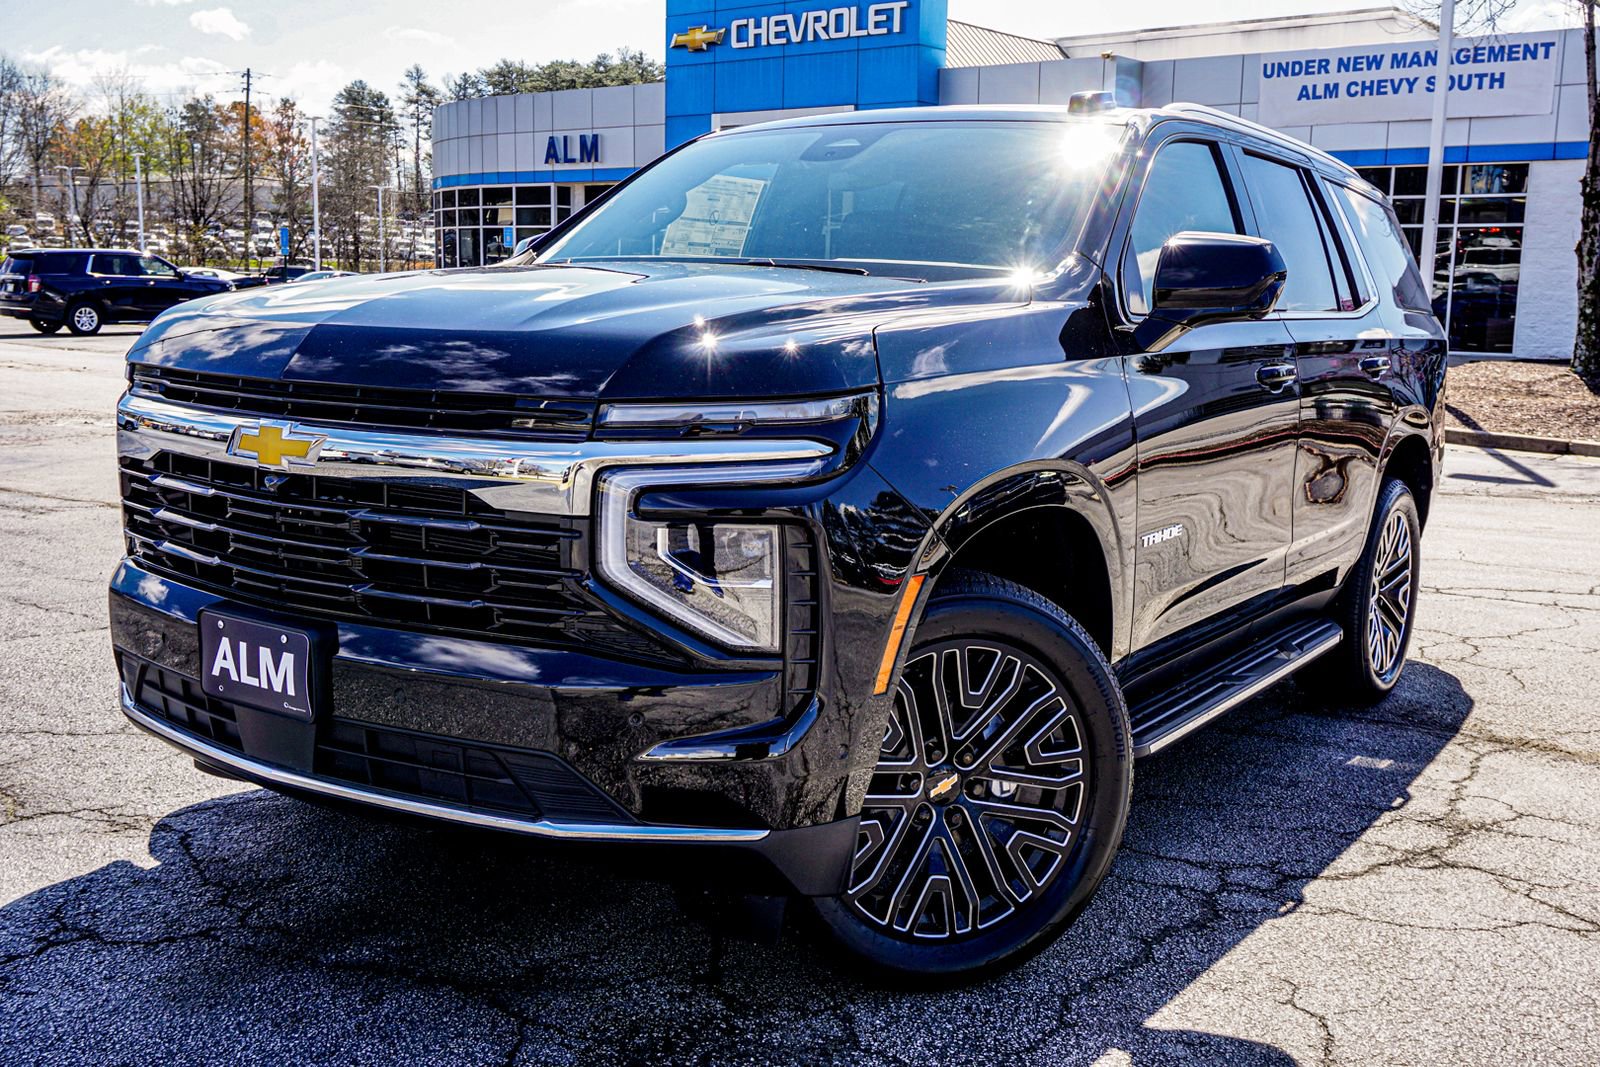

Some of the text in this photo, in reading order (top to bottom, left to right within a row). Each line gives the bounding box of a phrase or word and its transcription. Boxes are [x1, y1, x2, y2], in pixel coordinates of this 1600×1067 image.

[730, 1, 908, 49] CHEVROLET
[1263, 42, 1555, 79] UNDER NEW MANGEMENT
[1297, 82, 1340, 101] ALM
[1346, 77, 1420, 98] CHEVY
[544, 133, 600, 165] ALM
[1141, 523, 1183, 548] TAHOE
[211, 636, 296, 697] ALM
